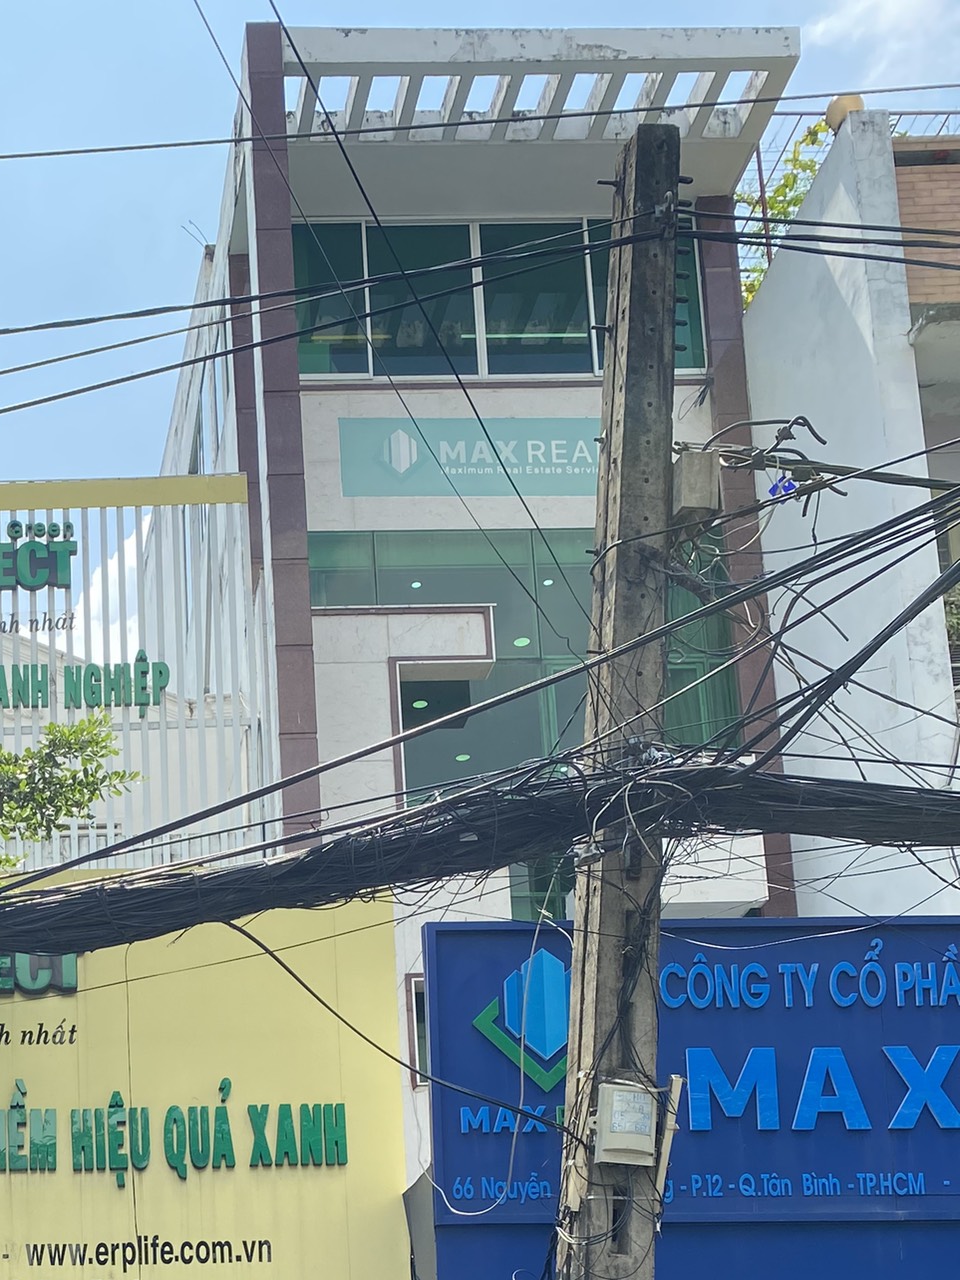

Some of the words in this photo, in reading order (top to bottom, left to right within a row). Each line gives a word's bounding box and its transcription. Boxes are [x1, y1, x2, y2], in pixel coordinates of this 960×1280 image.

[440, 440, 520, 464] MAX
[527, 440, 600, 464] REA
[441, 465, 493, 475] Maximum
[526, 465, 562, 475] Estate
[6, 520, 74, 540] Green
[64, 649, 170, 719] NGHIỆP
[658, 952, 771, 1009] CÔNG
[778, 962, 820, 1008] TY
[829, 938, 888, 1008] CỔ
[20, 1018, 77, 1046] nhất
[685, 1045, 960, 1131] MAX
[70, 1090, 151, 1188] HIỆU
[163, 1077, 236, 1181] QUẢ
[247, 1102, 348, 1168] XANH
[460, 1105, 547, 1134] MAX
[452, 1177, 473, 1200] 66
[481, 1172, 552, 1204] Nguyễn
[691, 1174, 724, 1198] P.12
[739, 1172, 793, 1198] Q.Tân
[802, 1171, 841, 1197] Bình
[25, 1235, 273, 1273] www.erplife.com.vn
